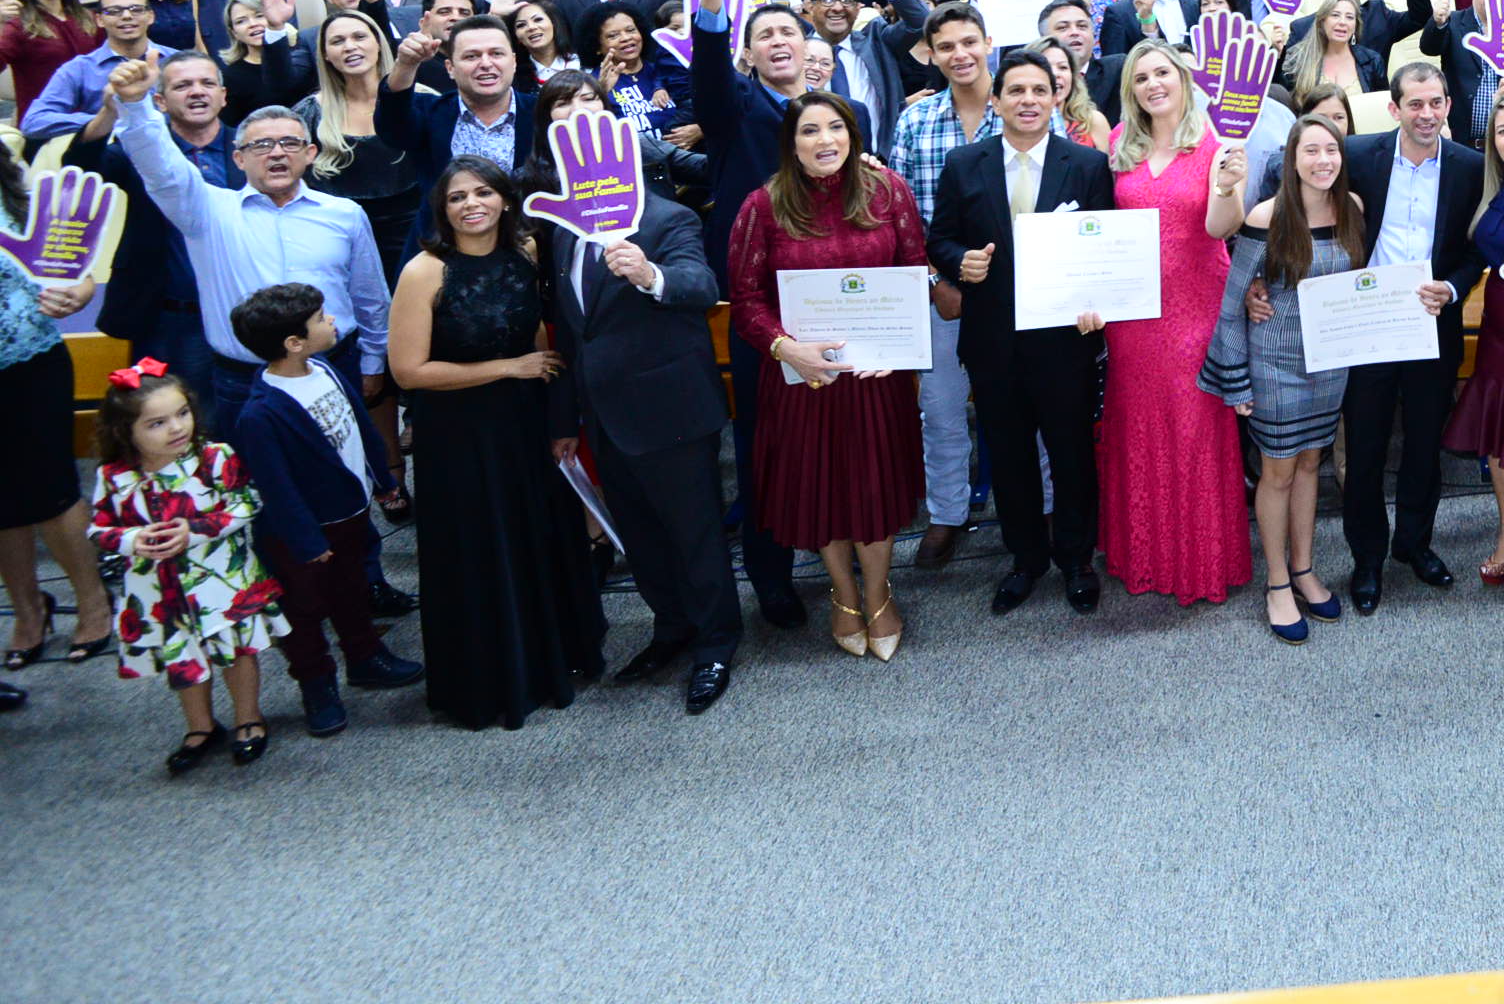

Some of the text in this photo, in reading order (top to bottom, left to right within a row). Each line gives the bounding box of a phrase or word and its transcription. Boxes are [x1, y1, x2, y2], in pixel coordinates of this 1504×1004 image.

[573, 176, 620, 191] Lute pela
[575, 182, 635, 200] sua Família!
